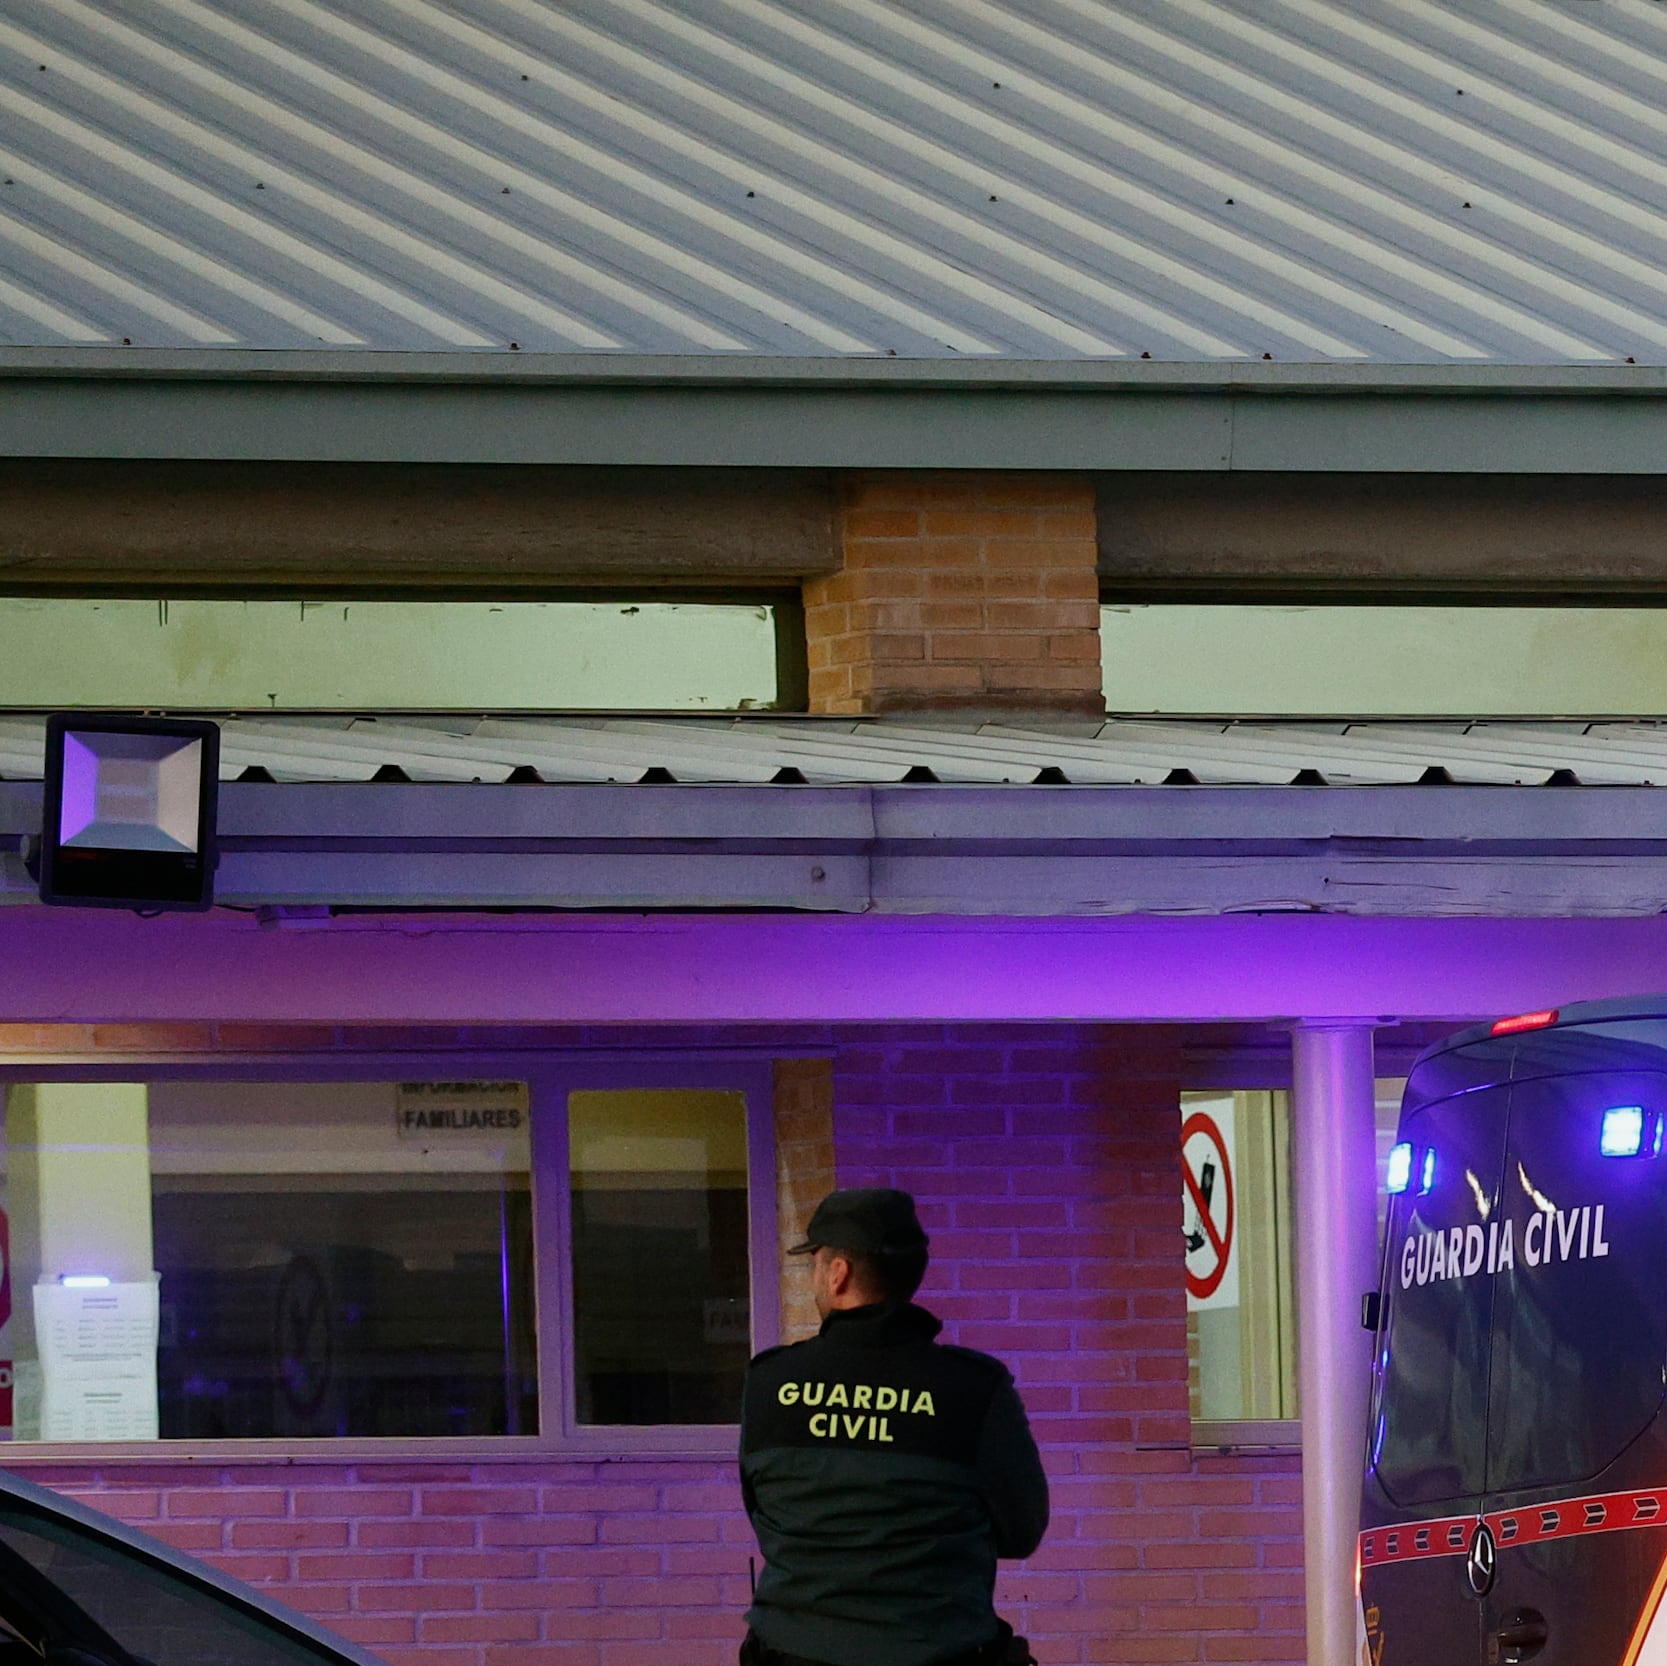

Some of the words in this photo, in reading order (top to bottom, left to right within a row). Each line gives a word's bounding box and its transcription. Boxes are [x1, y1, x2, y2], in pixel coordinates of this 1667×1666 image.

[404, 1109, 521, 1128] FAMILIARES
[1401, 1219, 1514, 1290] GUARDIA
[1525, 1204, 1609, 1267] CIVIL
[778, 1382, 935, 1416] GUARDIA
[809, 1413, 894, 1442] CIVIL
